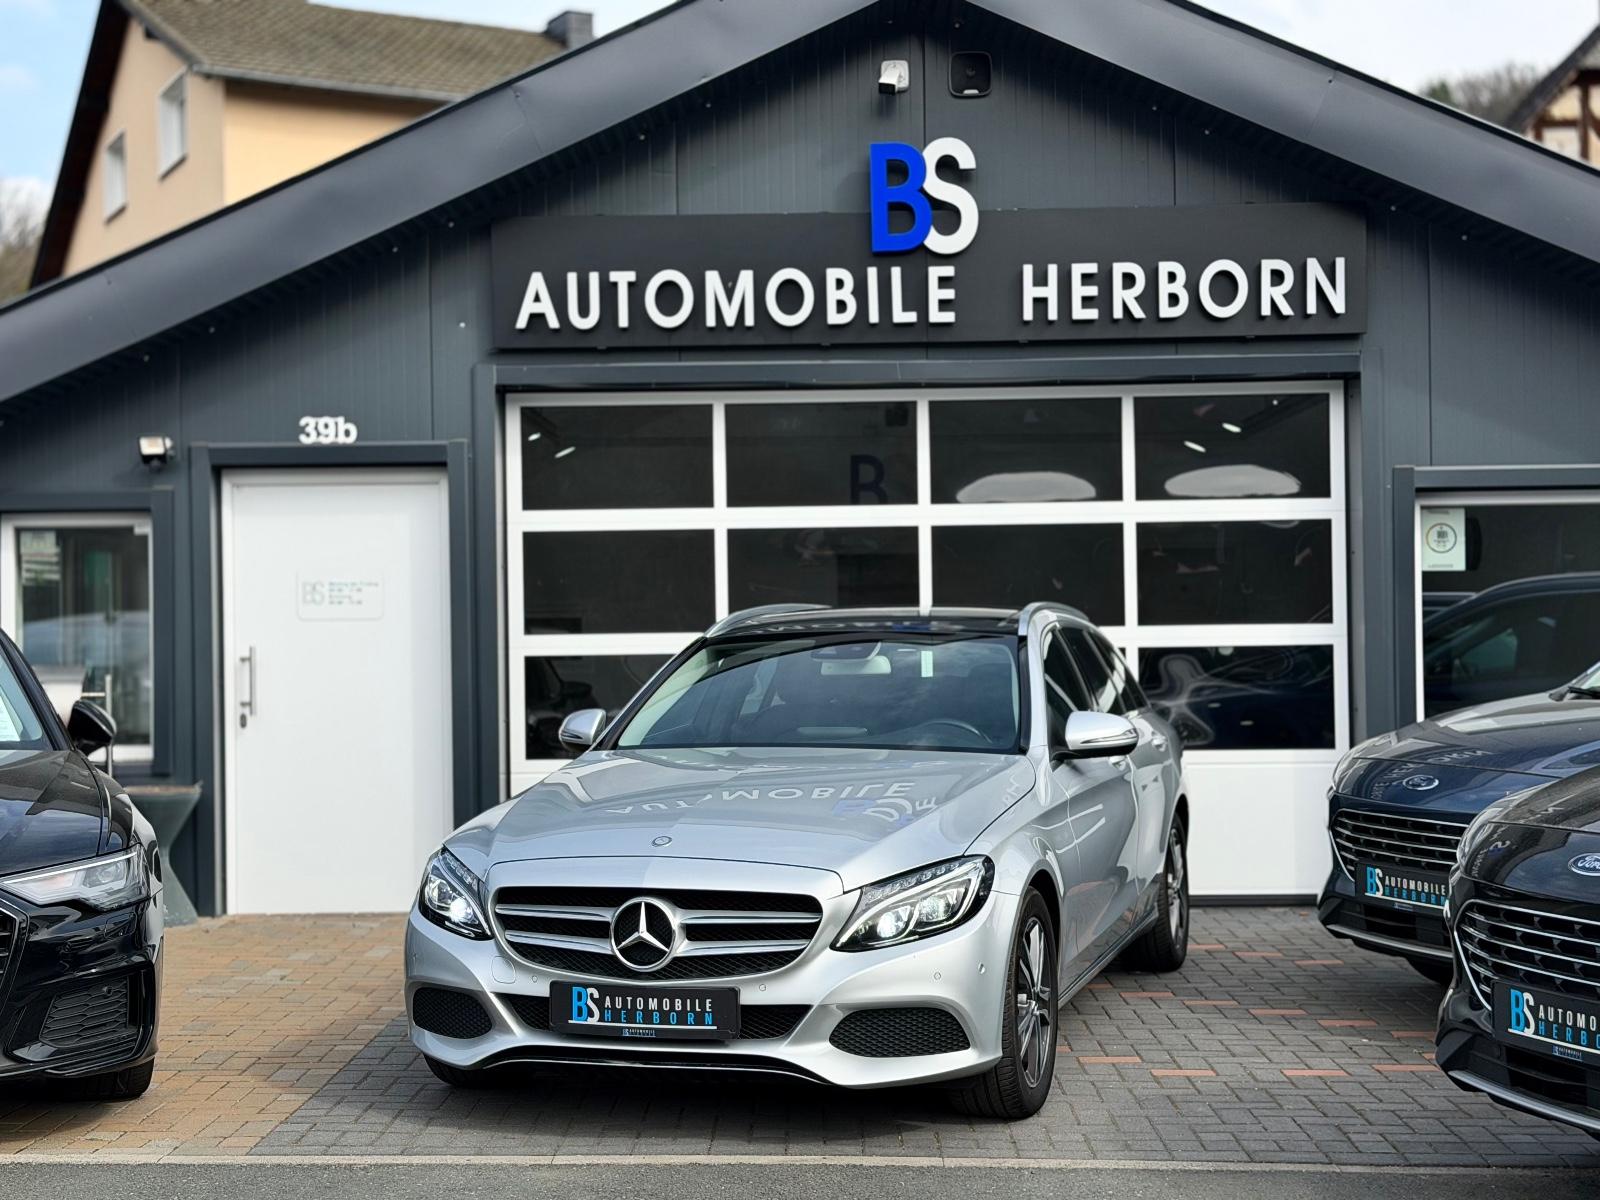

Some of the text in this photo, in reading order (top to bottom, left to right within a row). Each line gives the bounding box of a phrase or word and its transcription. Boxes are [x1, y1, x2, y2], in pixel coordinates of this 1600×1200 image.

[869, 137, 980, 255] BS
[515, 256, 1347, 331] AUTOMOBILE HERBORN
[299, 416, 358, 444] 39b
[1366, 866, 1384, 897] BS
[1384, 875, 1446, 896] AUTOMOBILE
[572, 986, 600, 1023] BS
[604, 995, 713, 1012] AUTOMOBILE
[604, 1009, 713, 1025] HERBORN
[1510, 989, 1536, 1036] BS
